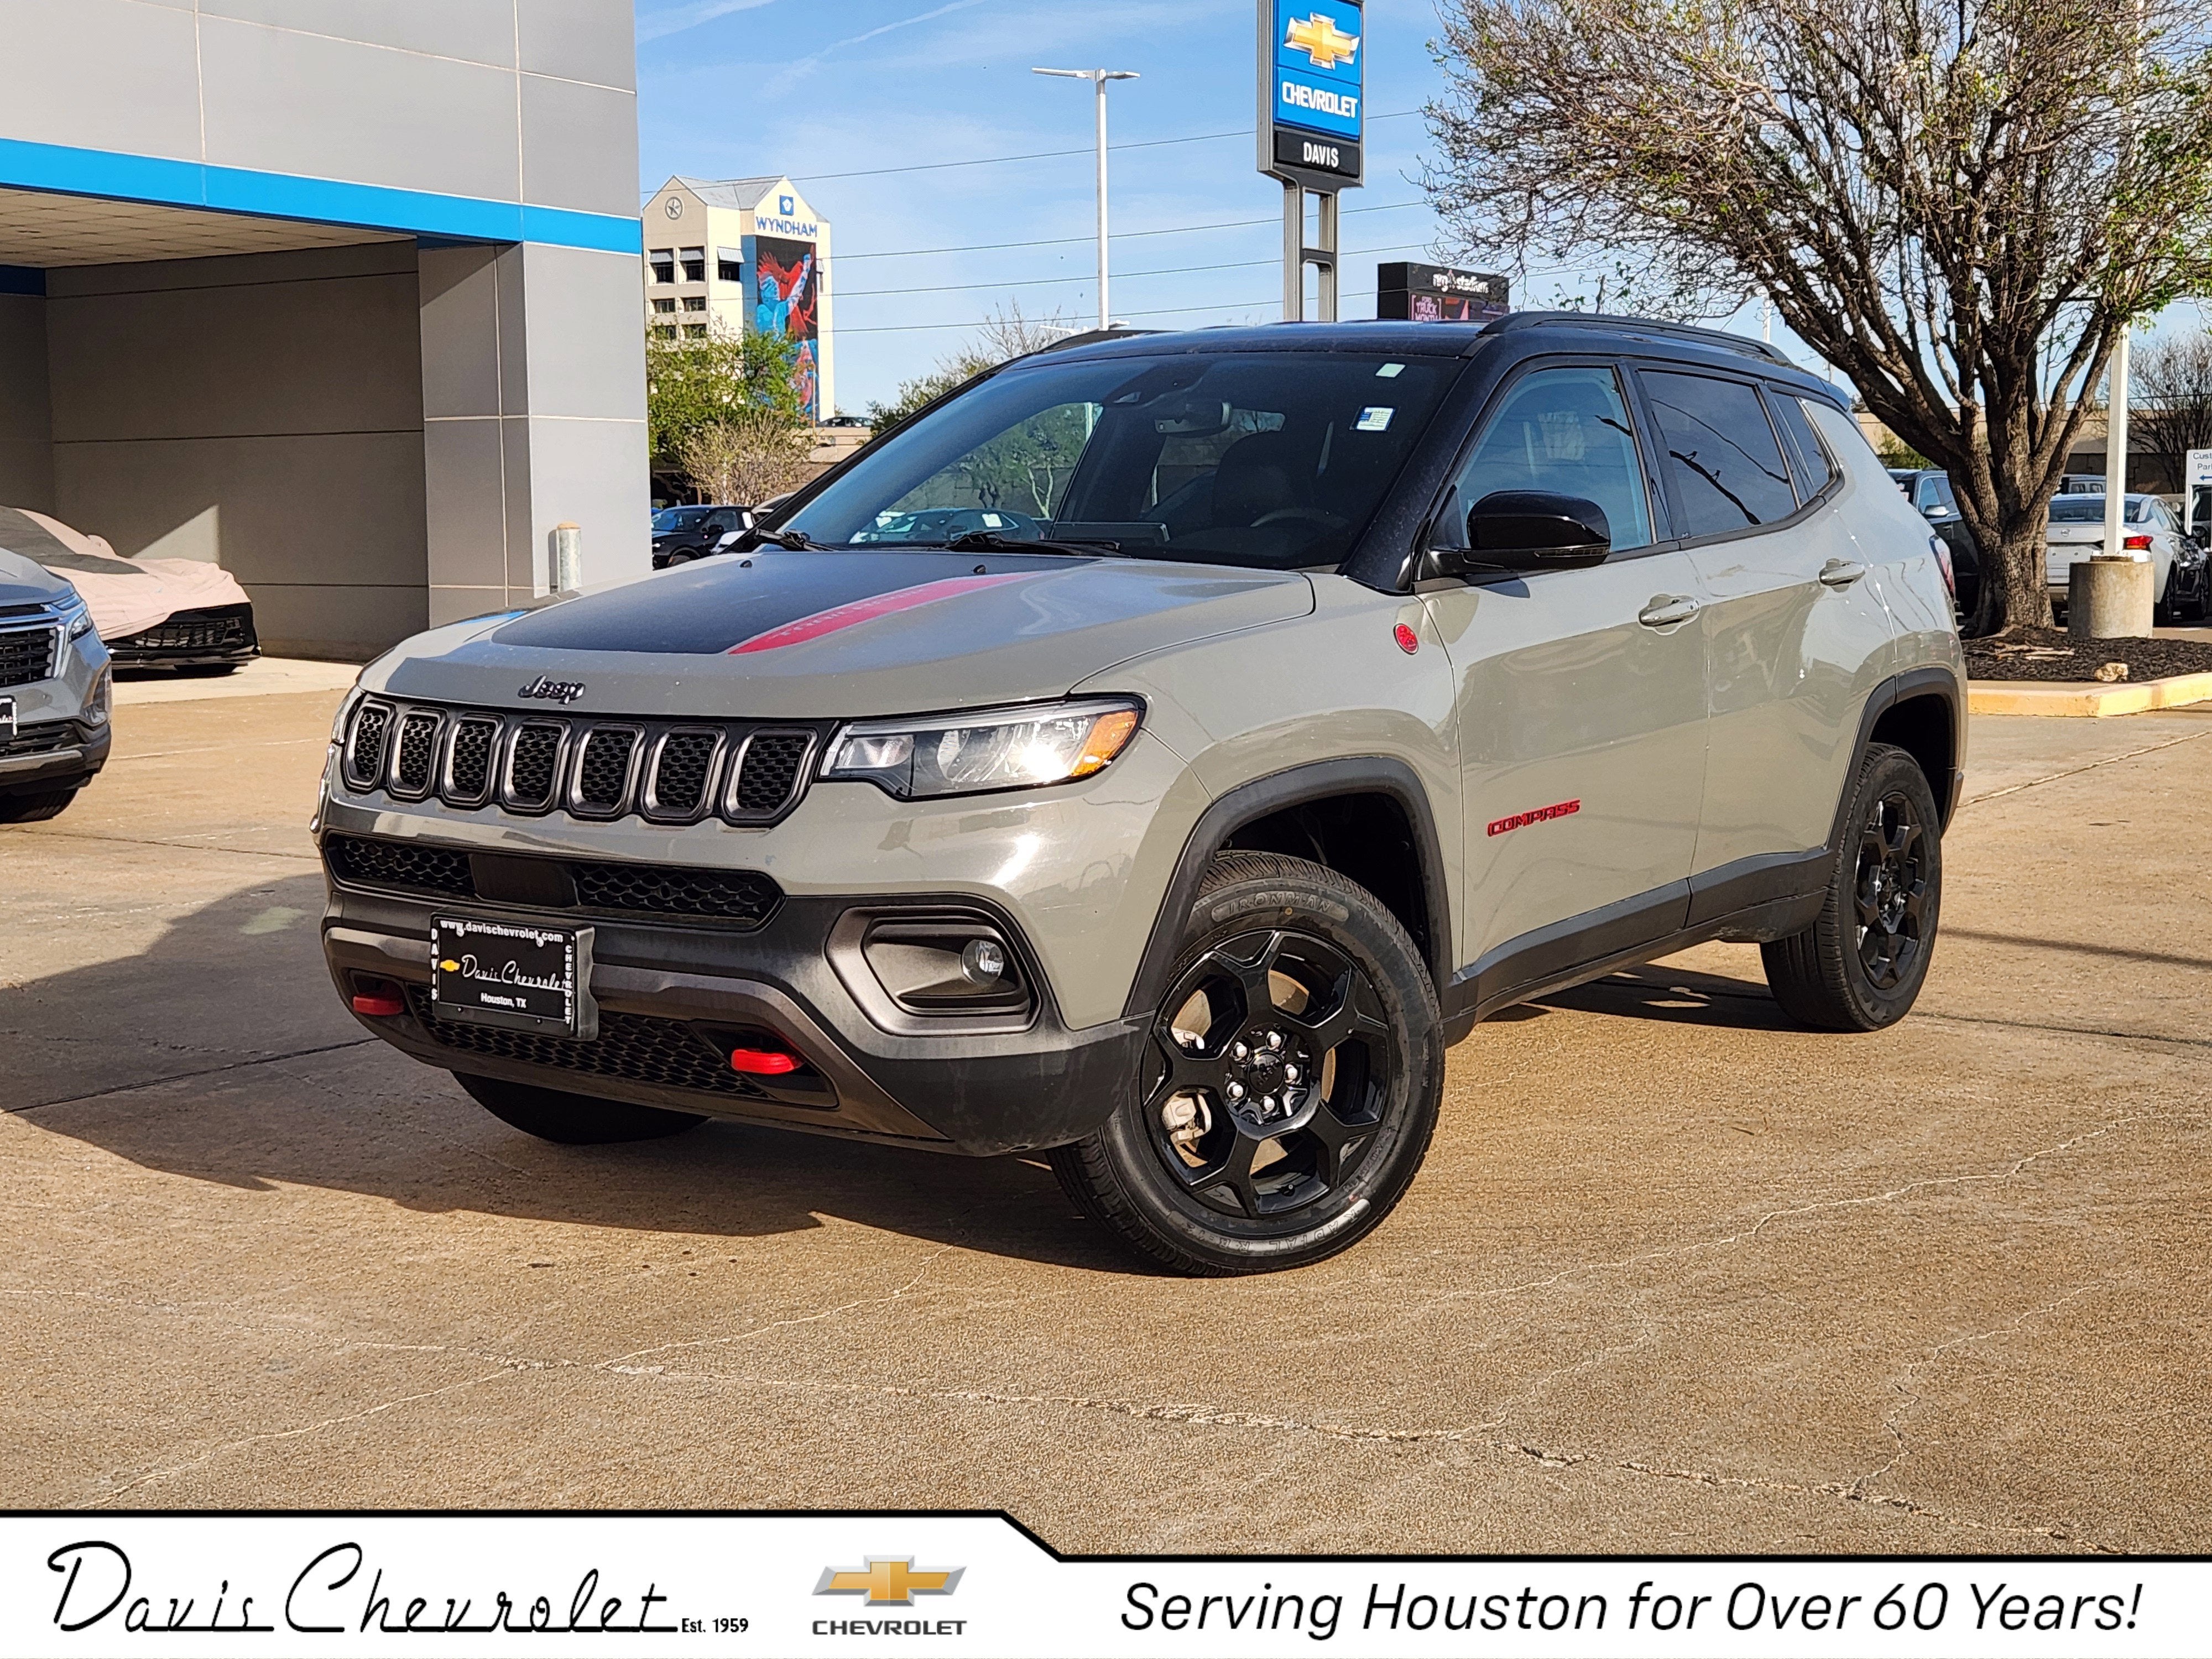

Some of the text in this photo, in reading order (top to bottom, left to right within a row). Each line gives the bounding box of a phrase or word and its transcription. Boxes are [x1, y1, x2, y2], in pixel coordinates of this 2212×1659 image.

[1282, 82, 1358, 118] CHEVROLET
[1303, 142, 1338, 167] DAVIS
[756, 216, 817, 237] WYNDHAM
[1416, 301, 1437, 315] TRUCK
[518, 675, 586, 705] Jeep
[1487, 799, 1580, 837] COMPASS
[1229, 891, 1331, 915] IRONMAN
[440, 920, 564, 943] www.davischevrolet.com
[461, 954, 502, 982] Davis
[565, 945, 573, 1024] CHEVROLET
[481, 993, 526, 1008] Houston, TX
